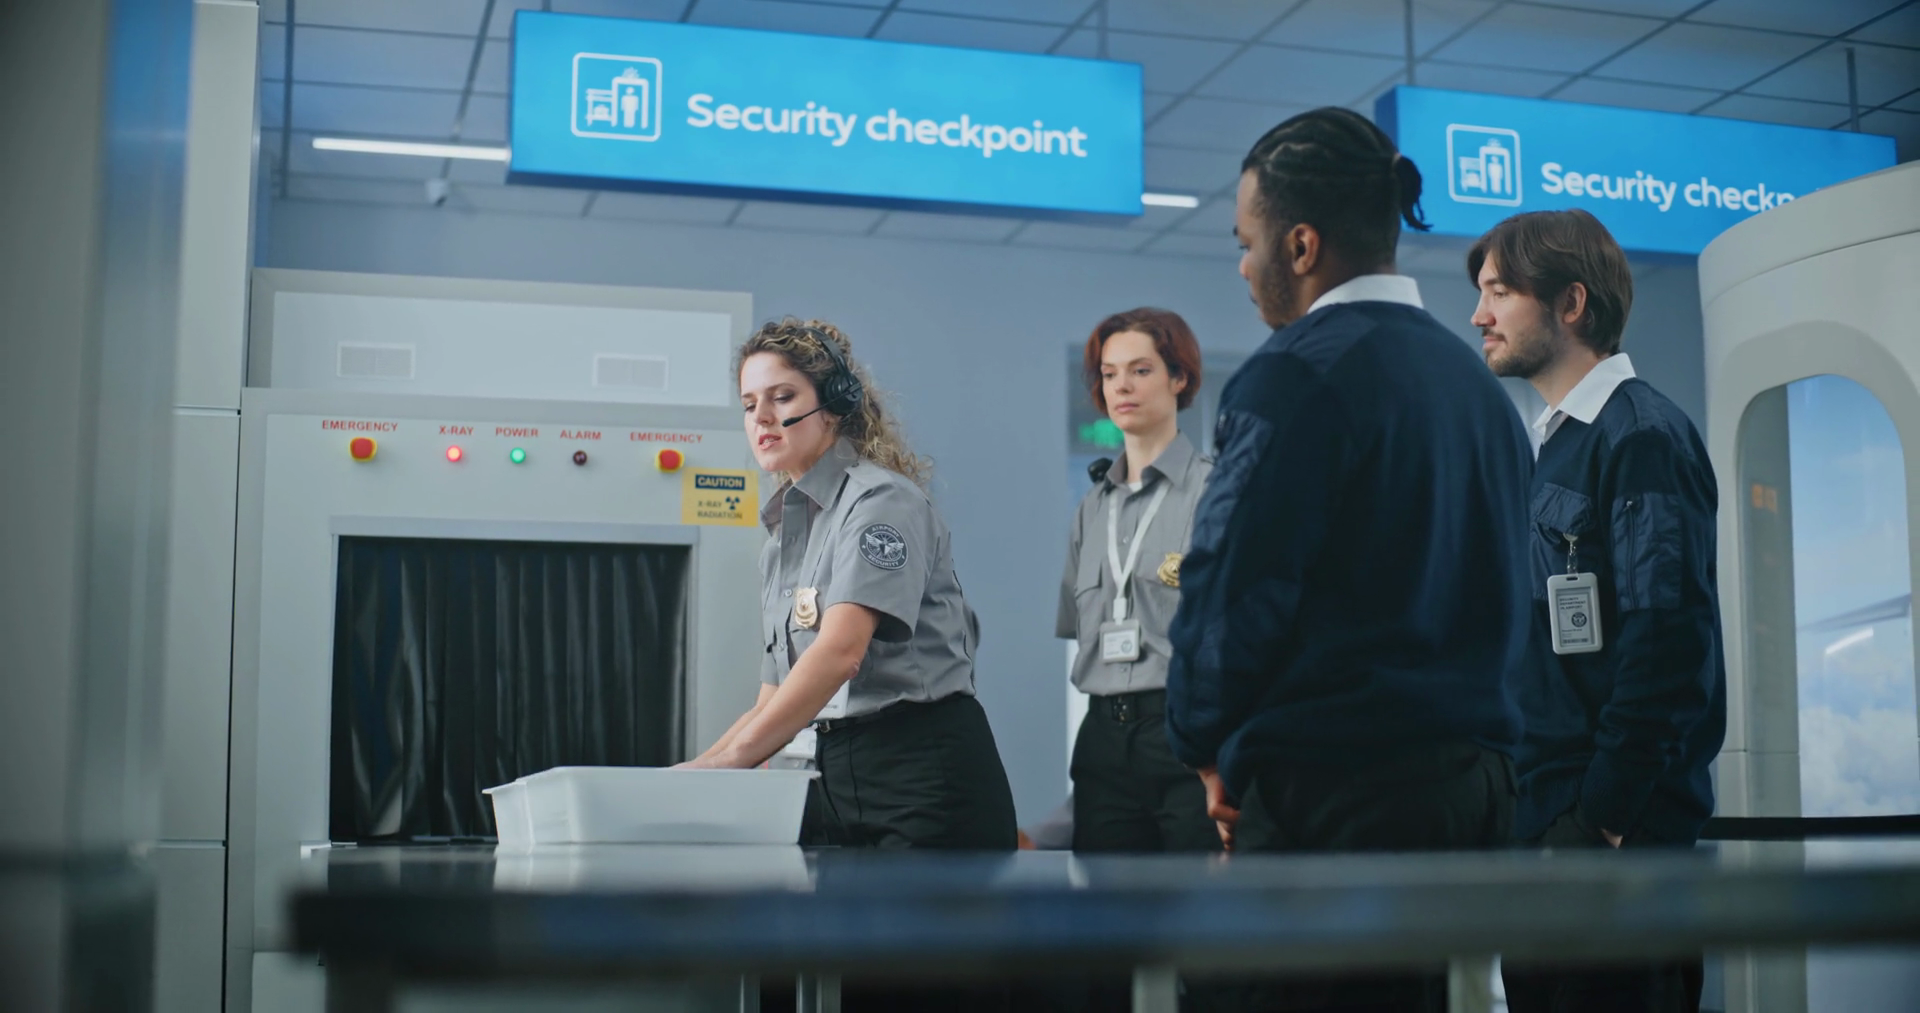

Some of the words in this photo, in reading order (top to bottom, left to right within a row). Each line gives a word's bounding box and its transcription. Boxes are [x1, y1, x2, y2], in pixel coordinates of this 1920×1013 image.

[686, 93, 857, 147] Security
[865, 108, 1088, 158] checkpoint
[1541, 162, 1677, 213] Security
[322, 419, 399, 432] EMERGENCY
[439, 425, 474, 436] X-RAY
[495, 426, 539, 438] POWER
[560, 429, 602, 441] ALARM
[630, 431, 703, 444] EMERGENCY
[697, 476, 743, 488] CAUTION
[698, 500, 722, 508] X-RAY
[697, 510, 743, 519] RADIATION
[872, 525, 899, 537] AIRPORT
[868, 554, 900, 567] SECURITY
